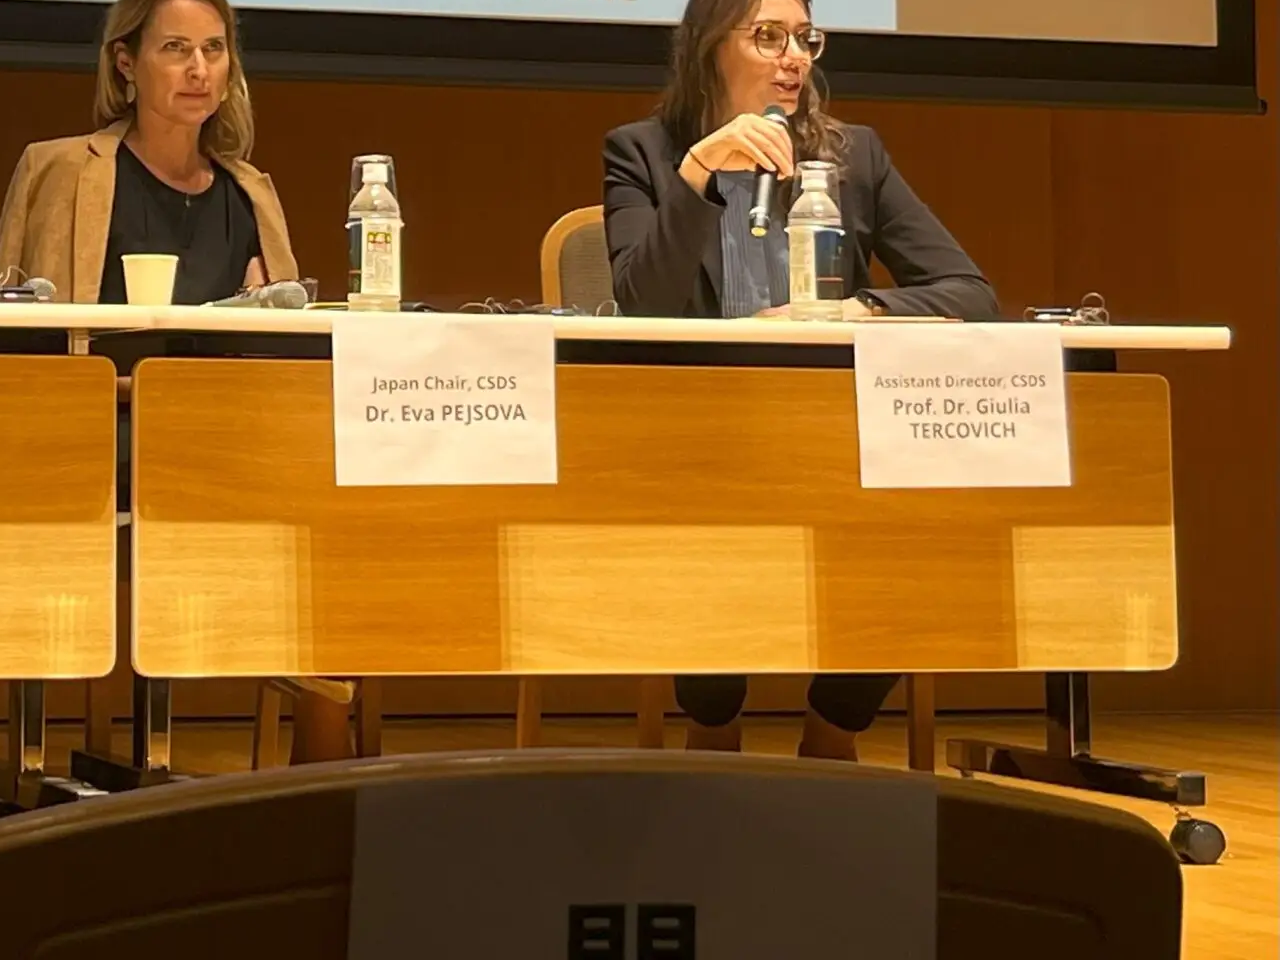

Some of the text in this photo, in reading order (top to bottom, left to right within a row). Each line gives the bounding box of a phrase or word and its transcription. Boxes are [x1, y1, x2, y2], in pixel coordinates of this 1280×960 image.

[371, 376, 517, 394] Japan Chair, CSDS
[874, 374, 1046, 390] Assistant Director, CSDS
[366, 403, 527, 426] Dr. Eva PEJSOVA
[893, 397, 1030, 416] Prof. Dr. Giulia
[910, 421, 1017, 440] TERCOVICH
